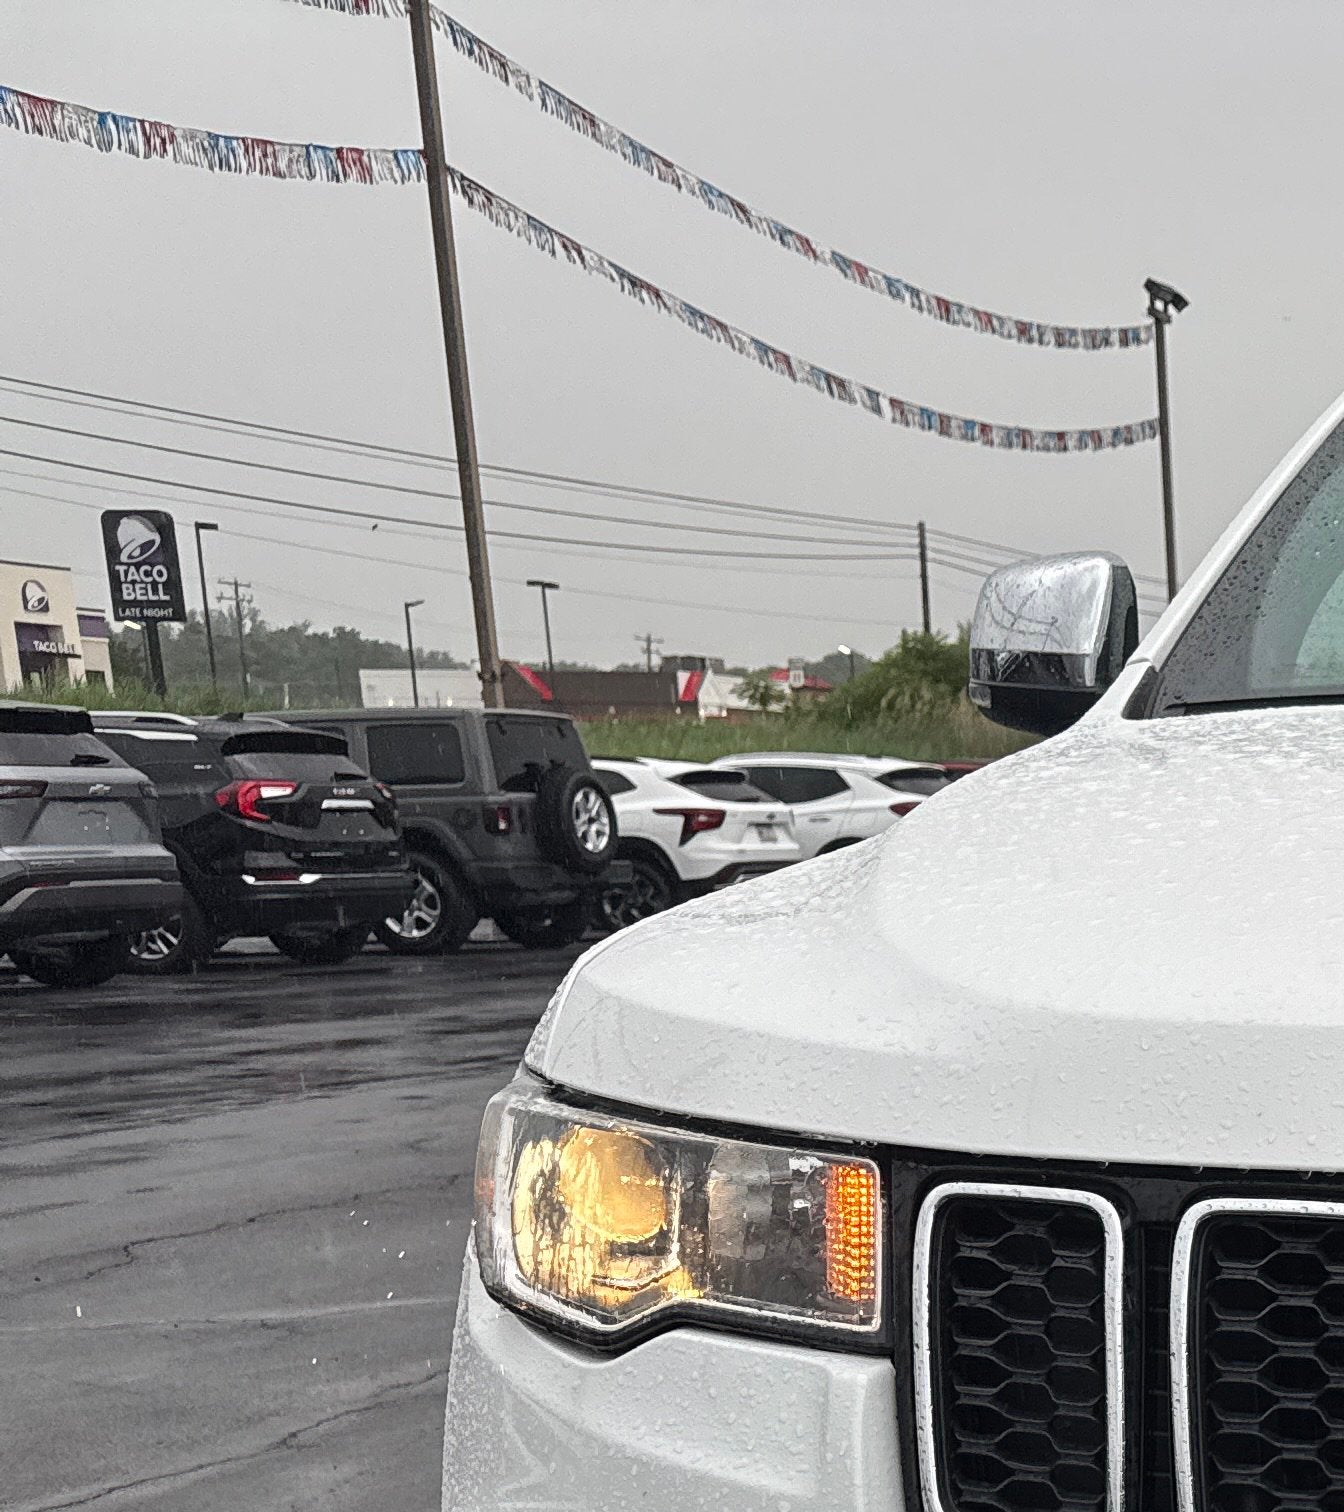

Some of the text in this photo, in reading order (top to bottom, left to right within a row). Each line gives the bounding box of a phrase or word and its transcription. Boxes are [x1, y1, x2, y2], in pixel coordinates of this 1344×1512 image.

[114, 564, 168, 583] TACO
[121, 583, 171, 601] BELL
[118, 607, 142, 617] LATE
[33, 640, 58, 654] TACO
